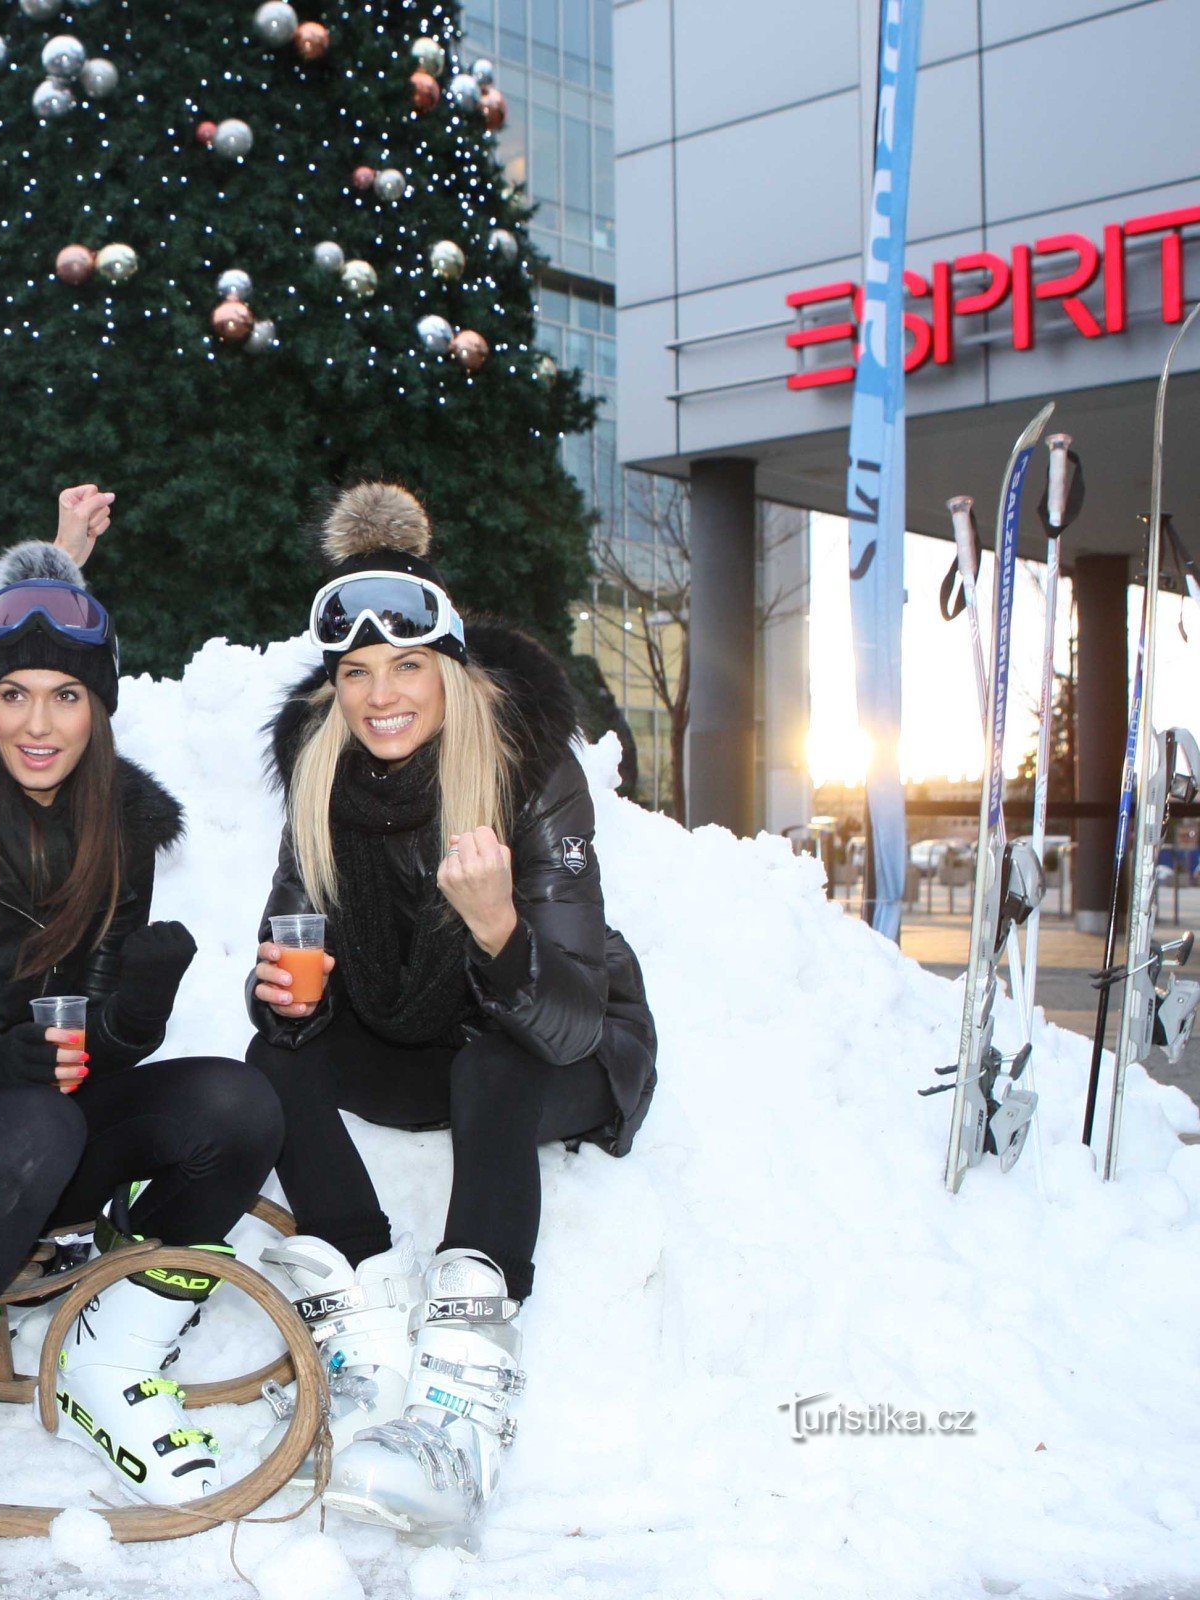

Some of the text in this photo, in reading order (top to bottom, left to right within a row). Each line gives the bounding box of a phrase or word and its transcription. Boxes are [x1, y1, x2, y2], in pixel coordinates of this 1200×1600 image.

[786, 205, 1200, 390] ESPRIT
[990, 472, 1021, 812] SALZBURGERLAND.COM
[144, 1268, 210, 1290] EAD
[56, 1391, 148, 1484] HEAD
